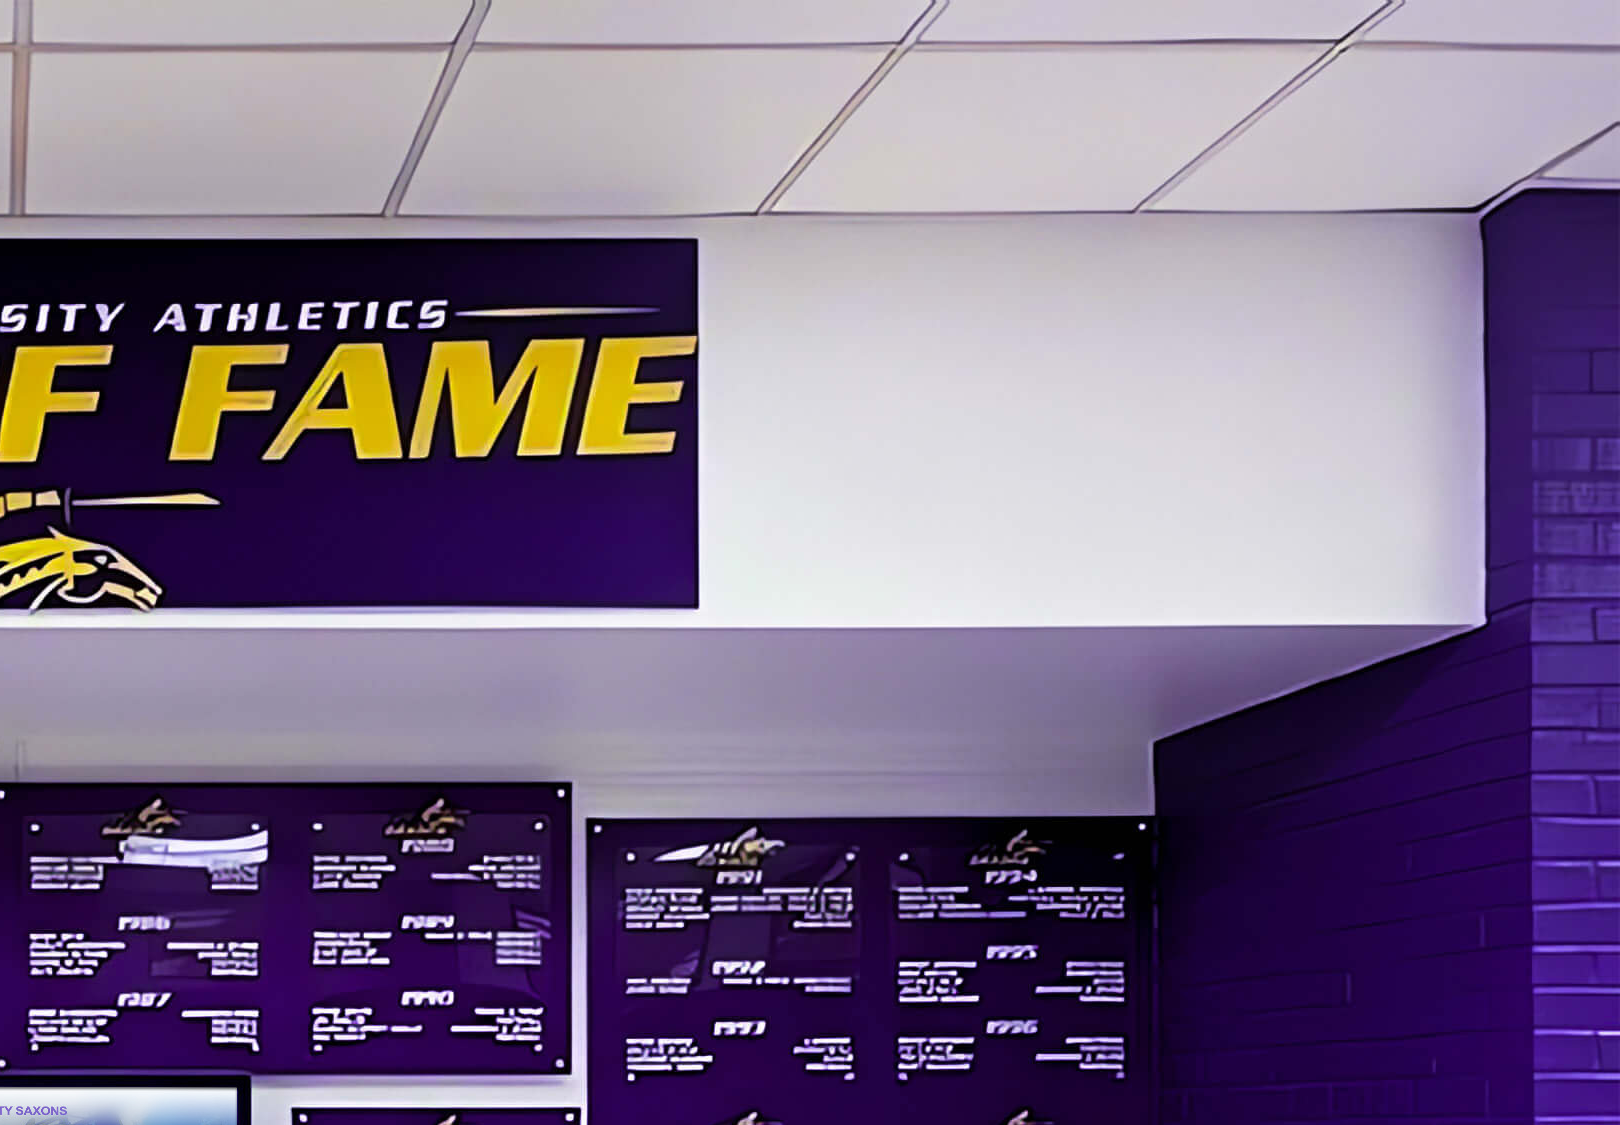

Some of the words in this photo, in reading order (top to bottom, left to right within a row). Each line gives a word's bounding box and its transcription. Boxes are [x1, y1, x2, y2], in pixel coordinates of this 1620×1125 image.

[154, 298, 452, 333] ATHLETICS
[169, 334, 696, 462] FAME
[15, 1106, 68, 1116] SAXONS
